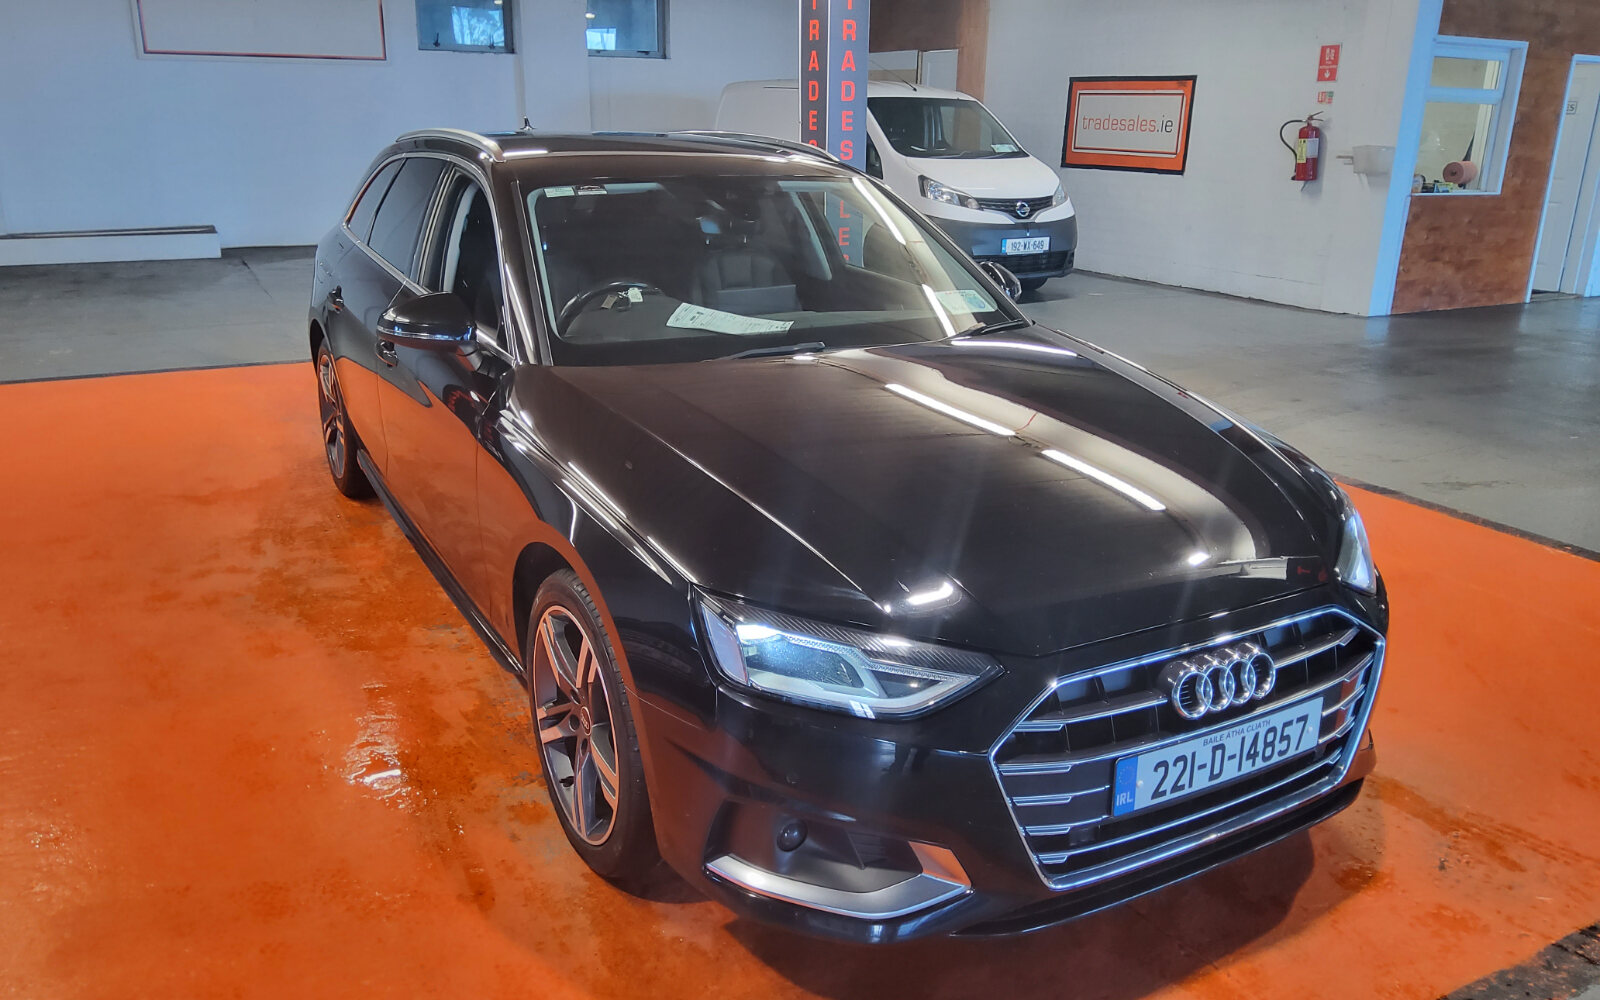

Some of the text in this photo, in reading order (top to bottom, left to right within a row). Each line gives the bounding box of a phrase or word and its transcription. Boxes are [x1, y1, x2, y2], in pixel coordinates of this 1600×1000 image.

[1082, 114, 1173, 133] tradesales.ie
[1203, 734, 1225, 747] BAILE
[1246, 719, 1271, 732] CLIATH
[1151, 714, 1309, 800] 221-D-14857
[1116, 793, 1134, 806] IRL
